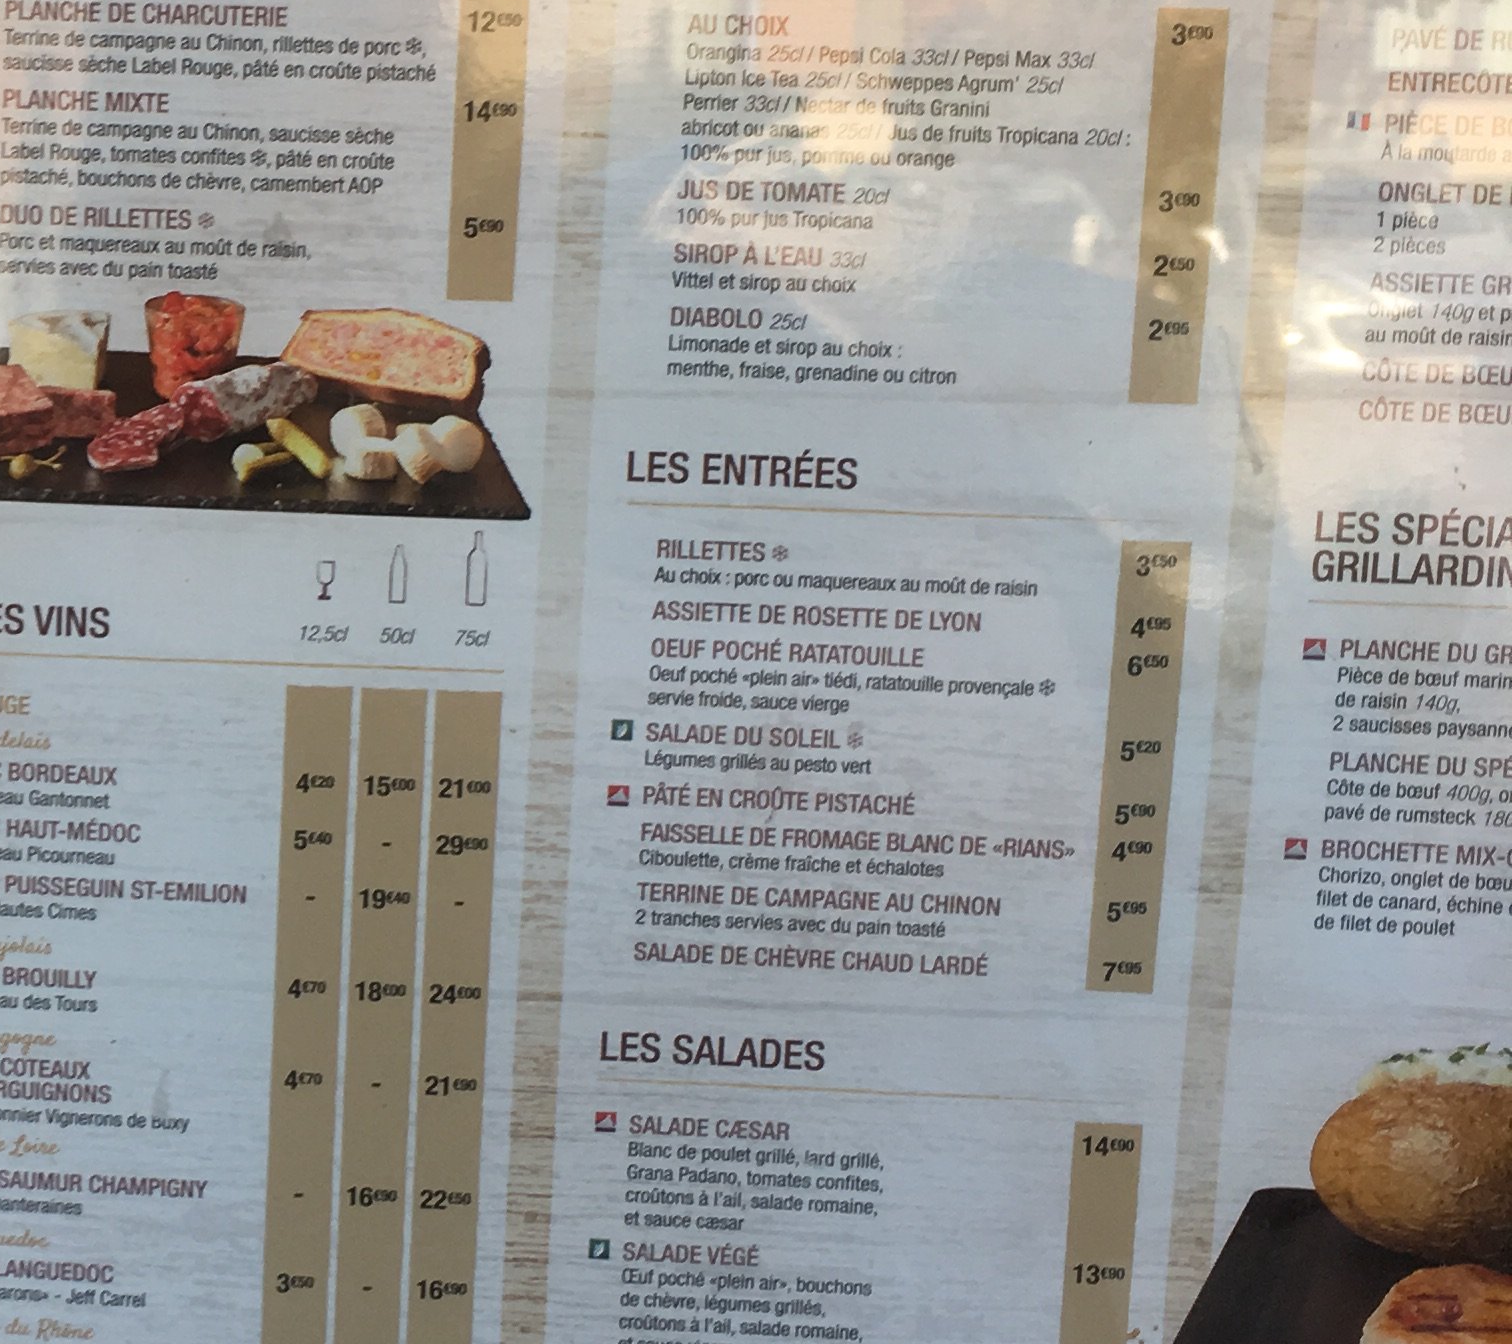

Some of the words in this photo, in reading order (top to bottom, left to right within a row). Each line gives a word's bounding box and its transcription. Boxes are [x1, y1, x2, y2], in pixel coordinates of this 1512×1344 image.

[4, 0, 101, 23] PLANCHE
[108, 2, 136, 24] DE
[143, 3, 288, 29] CHARCUTERIE
[688, 14, 717, 36] AU
[725, 14, 789, 37] CHOIX
[0, 167, 70, 188] pistaché,
[78, 170, 157, 189] bouchons
[161, 172, 182, 190] de
[187, 172, 245, 193] chèvre,
[250, 175, 343, 194] camembert
[347, 176, 383, 195] AOP
[670, 307, 763, 330] DIABOLO
[770, 311, 807, 332] 25cl
[667, 360, 734, 383] menthe,
[739, 361, 790, 384] fraise,
[795, 364, 879, 387] grenadine
[883, 366, 904, 384] ou
[909, 367, 957, 385] citron
[627, 451, 689, 484] LES
[702, 450, 858, 489] ENTRÉES
[1315, 511, 1380, 544] LES
[656, 540, 766, 562] RILLETTES
[34, 606, 111, 639] VINS
[380, 627, 415, 645] 50cl
[454, 629, 490, 647] 75cl
[1340, 639, 1440, 663] PLANCHE
[1447, 642, 1478, 663] DU
[646, 723, 726, 745] SALADE
[735, 726, 764, 746] DU
[769, 728, 841, 749] SOLEIL
[8, 764, 117, 785] BORDEAUX
[645, 750, 715, 772] Légumes
[720, 753, 766, 774] grillés
[771, 757, 789, 772] au
[795, 756, 837, 775] pesto
[841, 759, 871, 774] vert
[643, 784, 690, 806] PÂTÉ
[696, 788, 723, 808] EN
[728, 784, 809, 812] CROÛTE
[815, 789, 915, 816] PISTACHÉ
[1314, 912, 1335, 930] de
[1340, 913, 1371, 931] filet
[1377, 916, 1397, 933] de
[1403, 916, 1455, 936] poulet
[599, 1031, 660, 1063] LES
[673, 1034, 825, 1071] SALADES
[629, 1115, 710, 1137] SALADE
[716, 1119, 790, 1140] CÆSAR
[89, 1175, 208, 1198] CHAMPIGNY
[624, 1210, 640, 1226] et
[644, 1213, 691, 1228] sauce
[696, 1215, 744, 1230] cæsar
